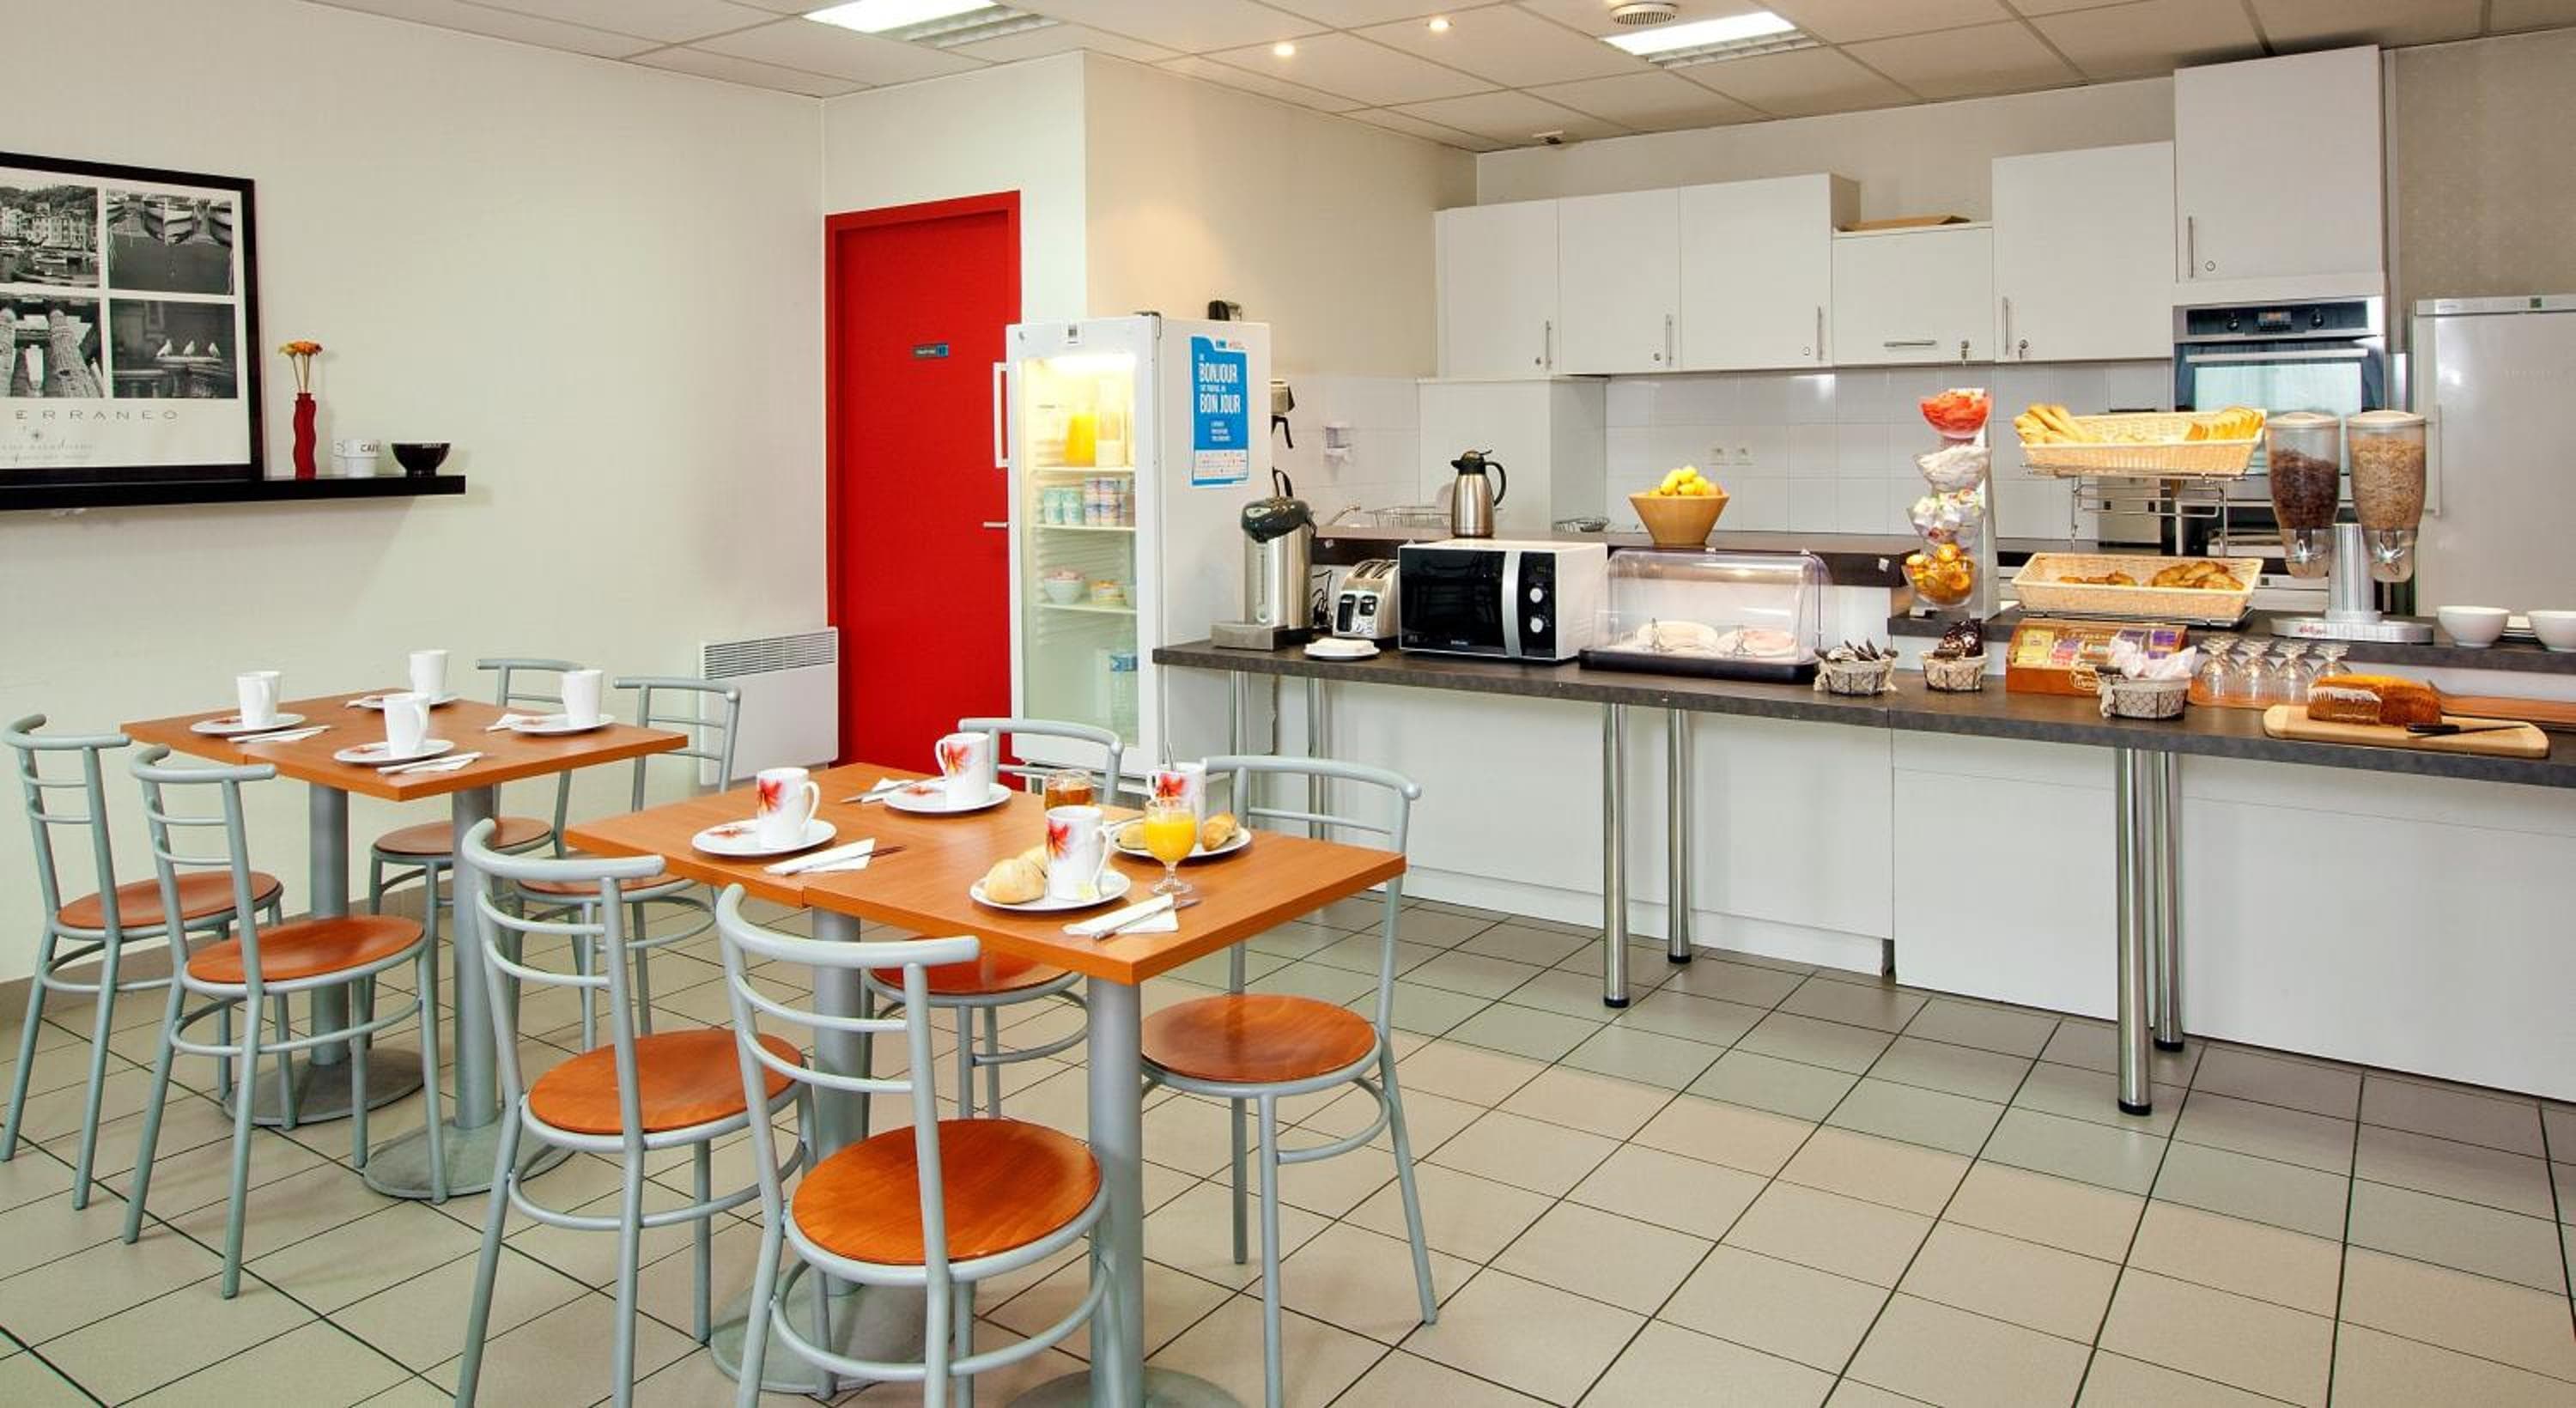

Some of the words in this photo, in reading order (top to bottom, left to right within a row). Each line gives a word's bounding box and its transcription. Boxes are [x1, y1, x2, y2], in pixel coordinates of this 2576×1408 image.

[1199, 362, 1237, 383] BONJOUR
[1200, 394, 1218, 413] BON
[1220, 395, 1241, 414] JOUR
